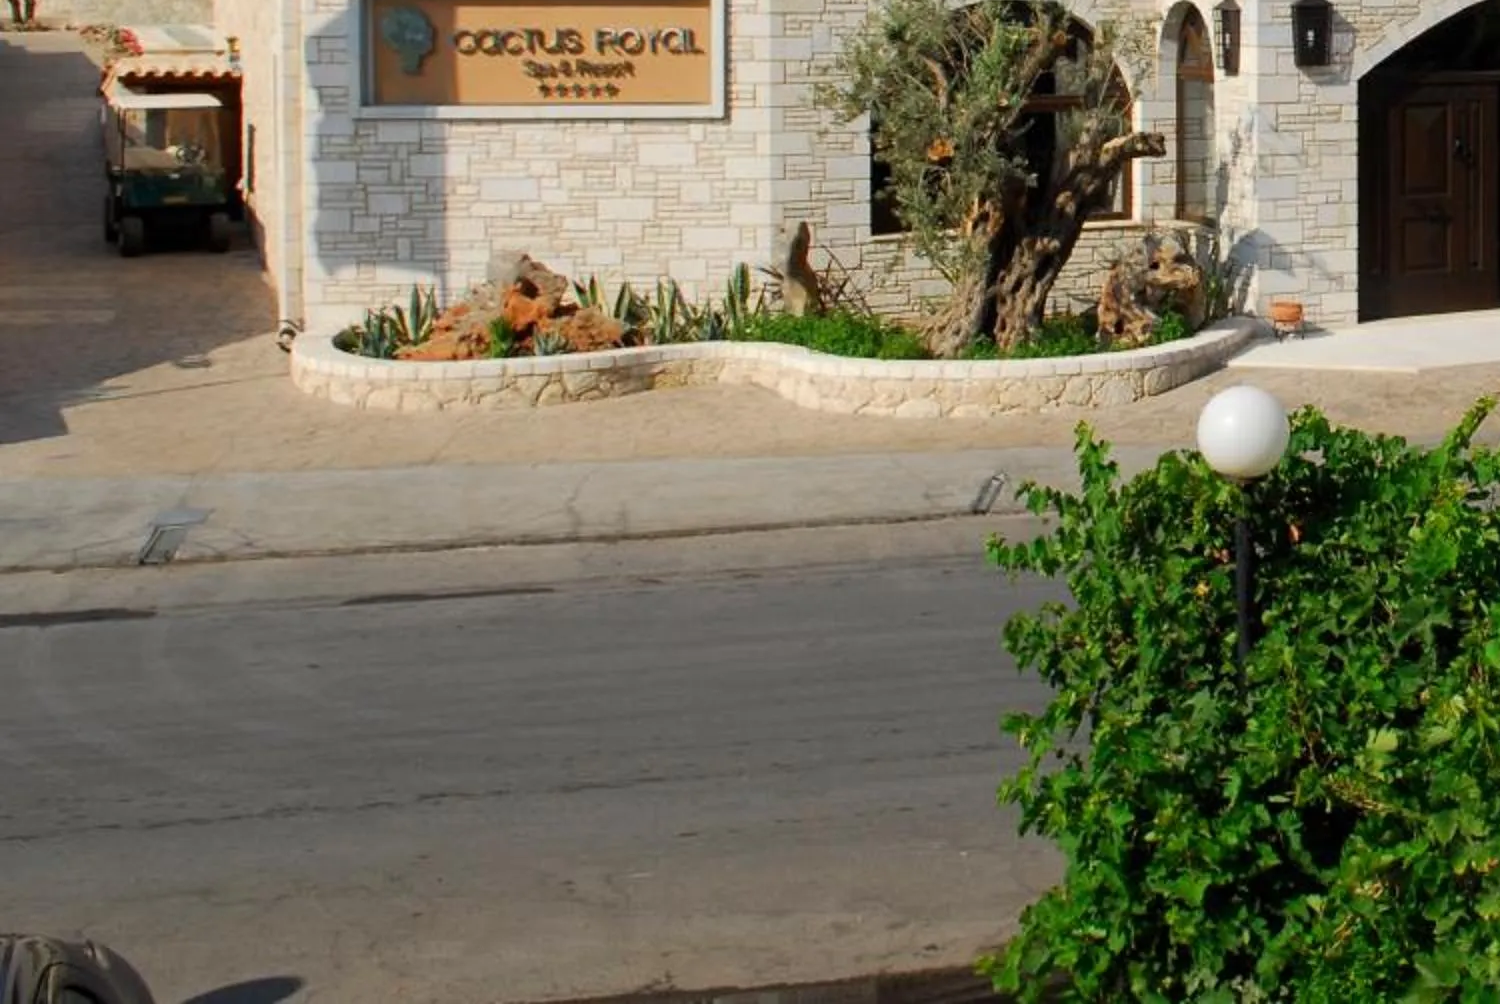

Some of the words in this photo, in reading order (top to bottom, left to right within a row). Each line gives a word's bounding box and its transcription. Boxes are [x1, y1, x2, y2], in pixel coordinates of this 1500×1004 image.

[594, 27, 706, 56] ROYAL
[522, 59, 559, 80] Spa
[560, 59, 574, 78] &
[575, 59, 636, 78] Resort
